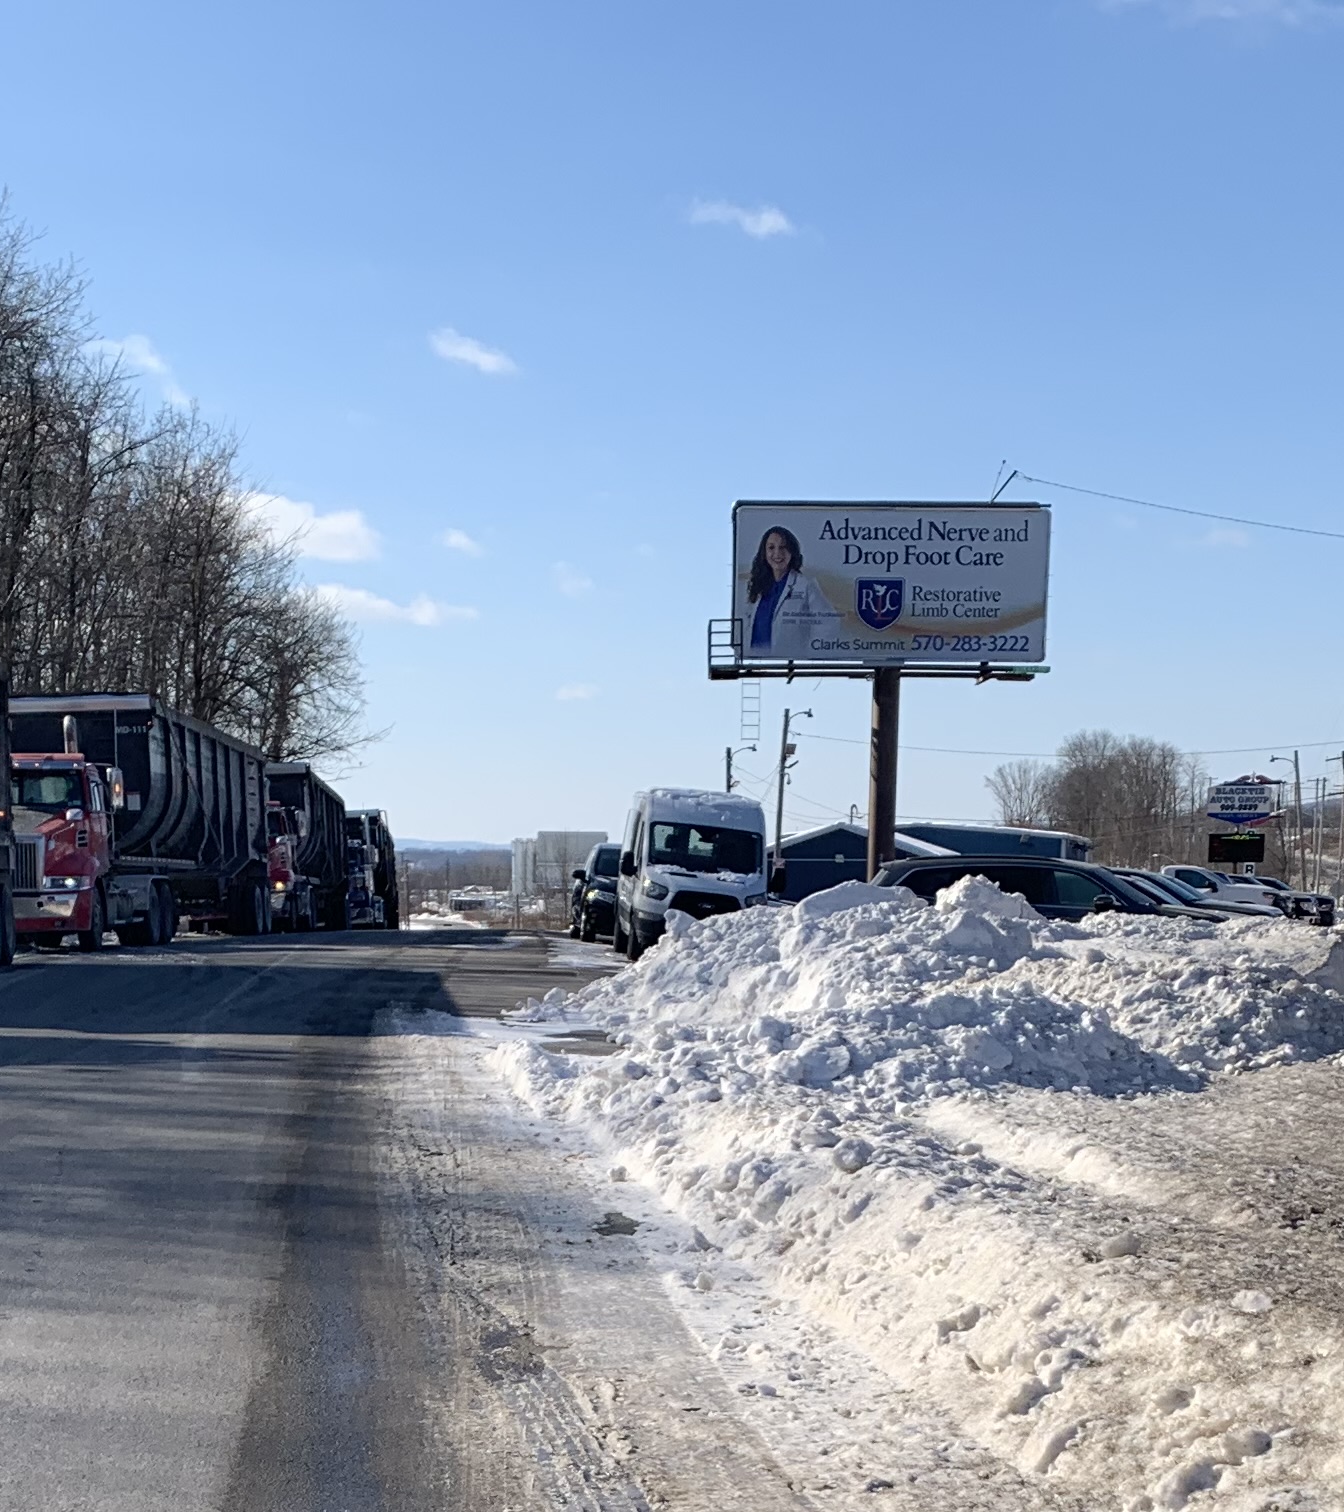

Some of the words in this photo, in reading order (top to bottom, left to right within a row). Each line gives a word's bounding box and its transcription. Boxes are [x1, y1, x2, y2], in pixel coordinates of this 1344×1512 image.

[818, 518, 923, 541] Advanced
[927, 521, 990, 542] Nerve
[993, 520, 1029, 542] and
[842, 544, 899, 572] Drop
[903, 545, 951, 566] Foot
[955, 545, 1004, 566] Care
[912, 586, 1002, 602] Restorative
[911, 603, 949, 617] Limb
[953, 603, 1000, 618] Center
[810, 638, 851, 650] Clarks
[853, 638, 905, 651] Summit
[911, 634, 1029, 652] 570-283-3222
